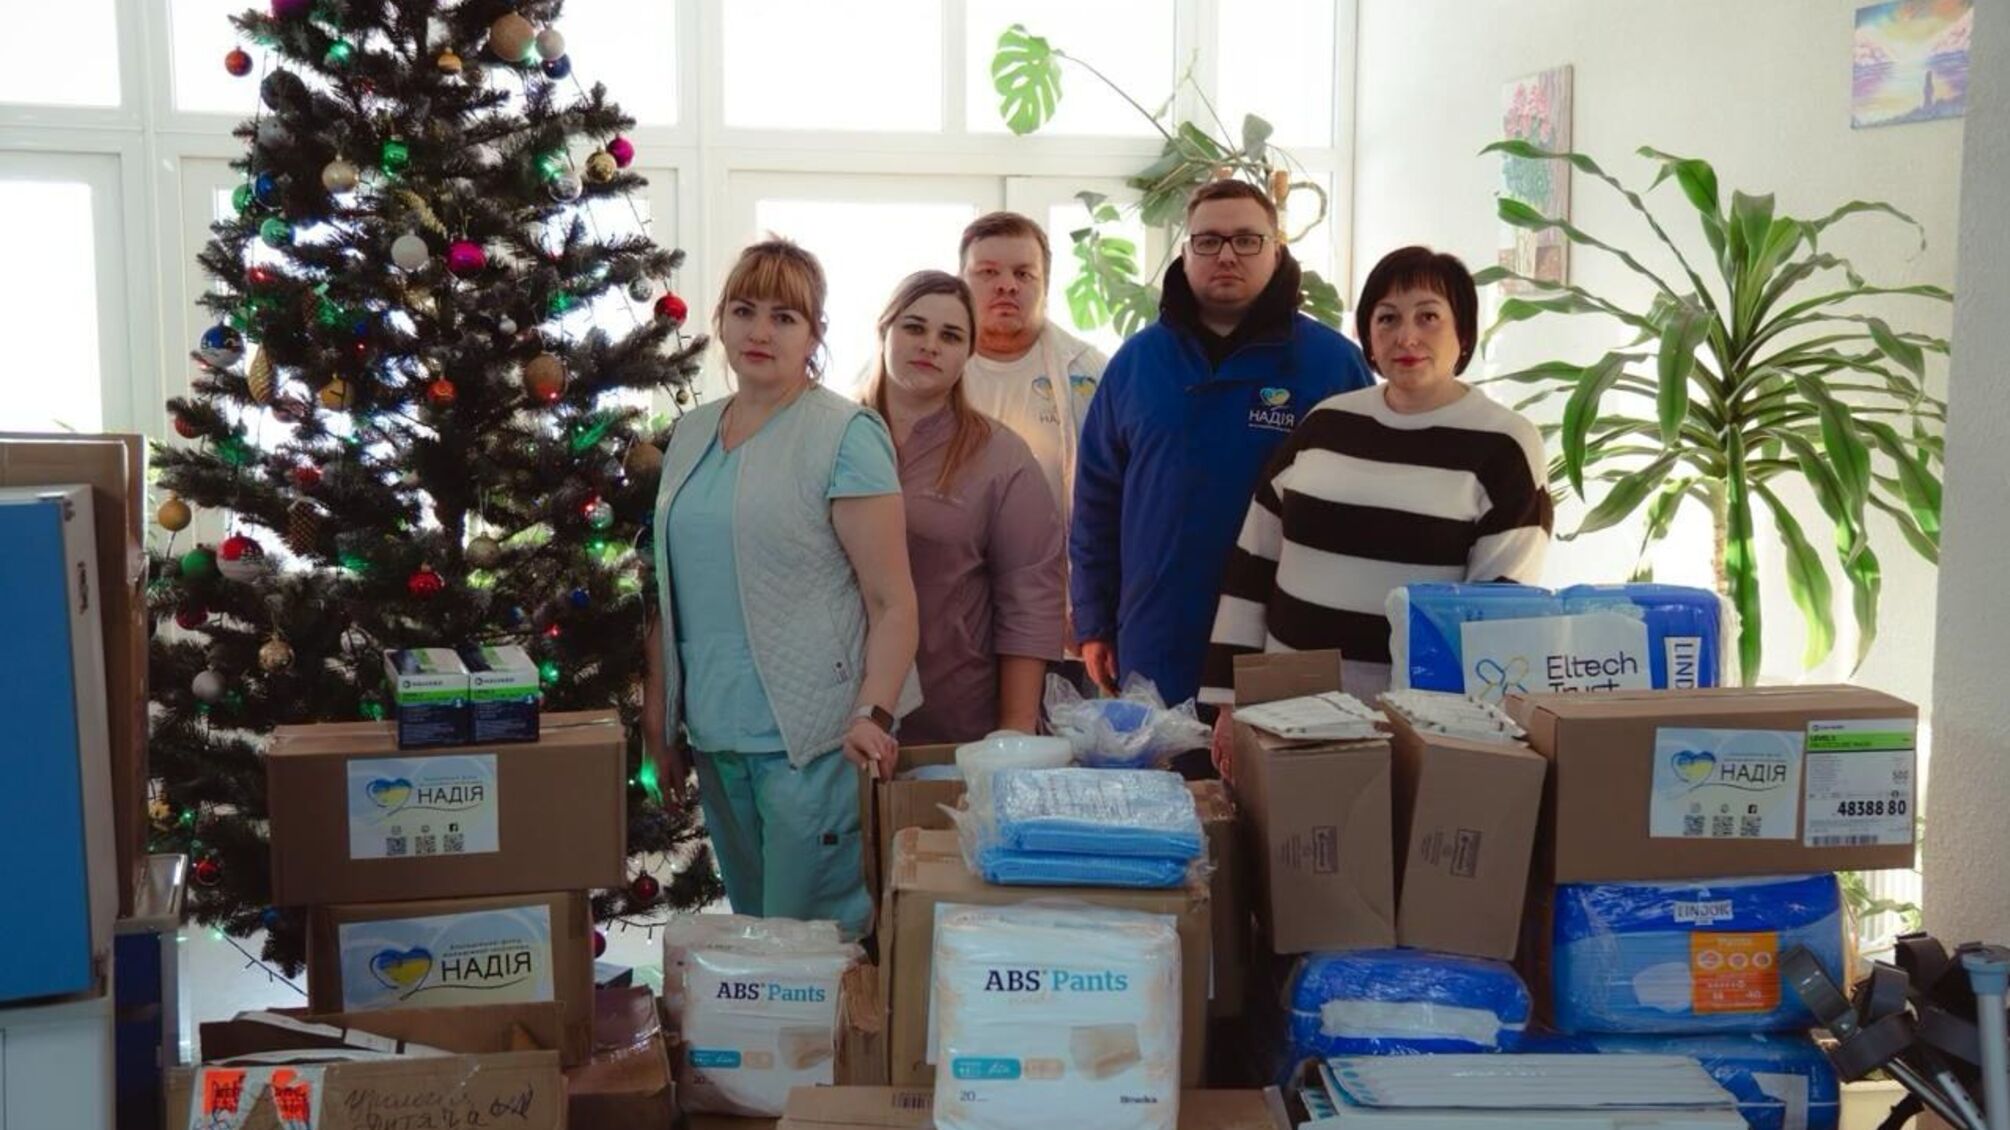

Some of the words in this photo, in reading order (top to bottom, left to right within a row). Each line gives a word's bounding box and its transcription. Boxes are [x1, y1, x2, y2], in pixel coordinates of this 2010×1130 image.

[1249, 410, 1295, 427] НАДІЯ
[1547, 651, 1638, 680] Eltech
[1721, 764, 1787, 783] НАДІЯ
[417, 785, 484, 804] НАДІЯ
[1838, 800, 1884, 816] 48388
[1888, 800, 1907, 815] 80
[441, 951, 532, 982] НАДІЯ
[1052, 969, 1129, 992] Pants
[768, 983, 826, 1002] Pants
[959, 1090, 976, 1102] 20
